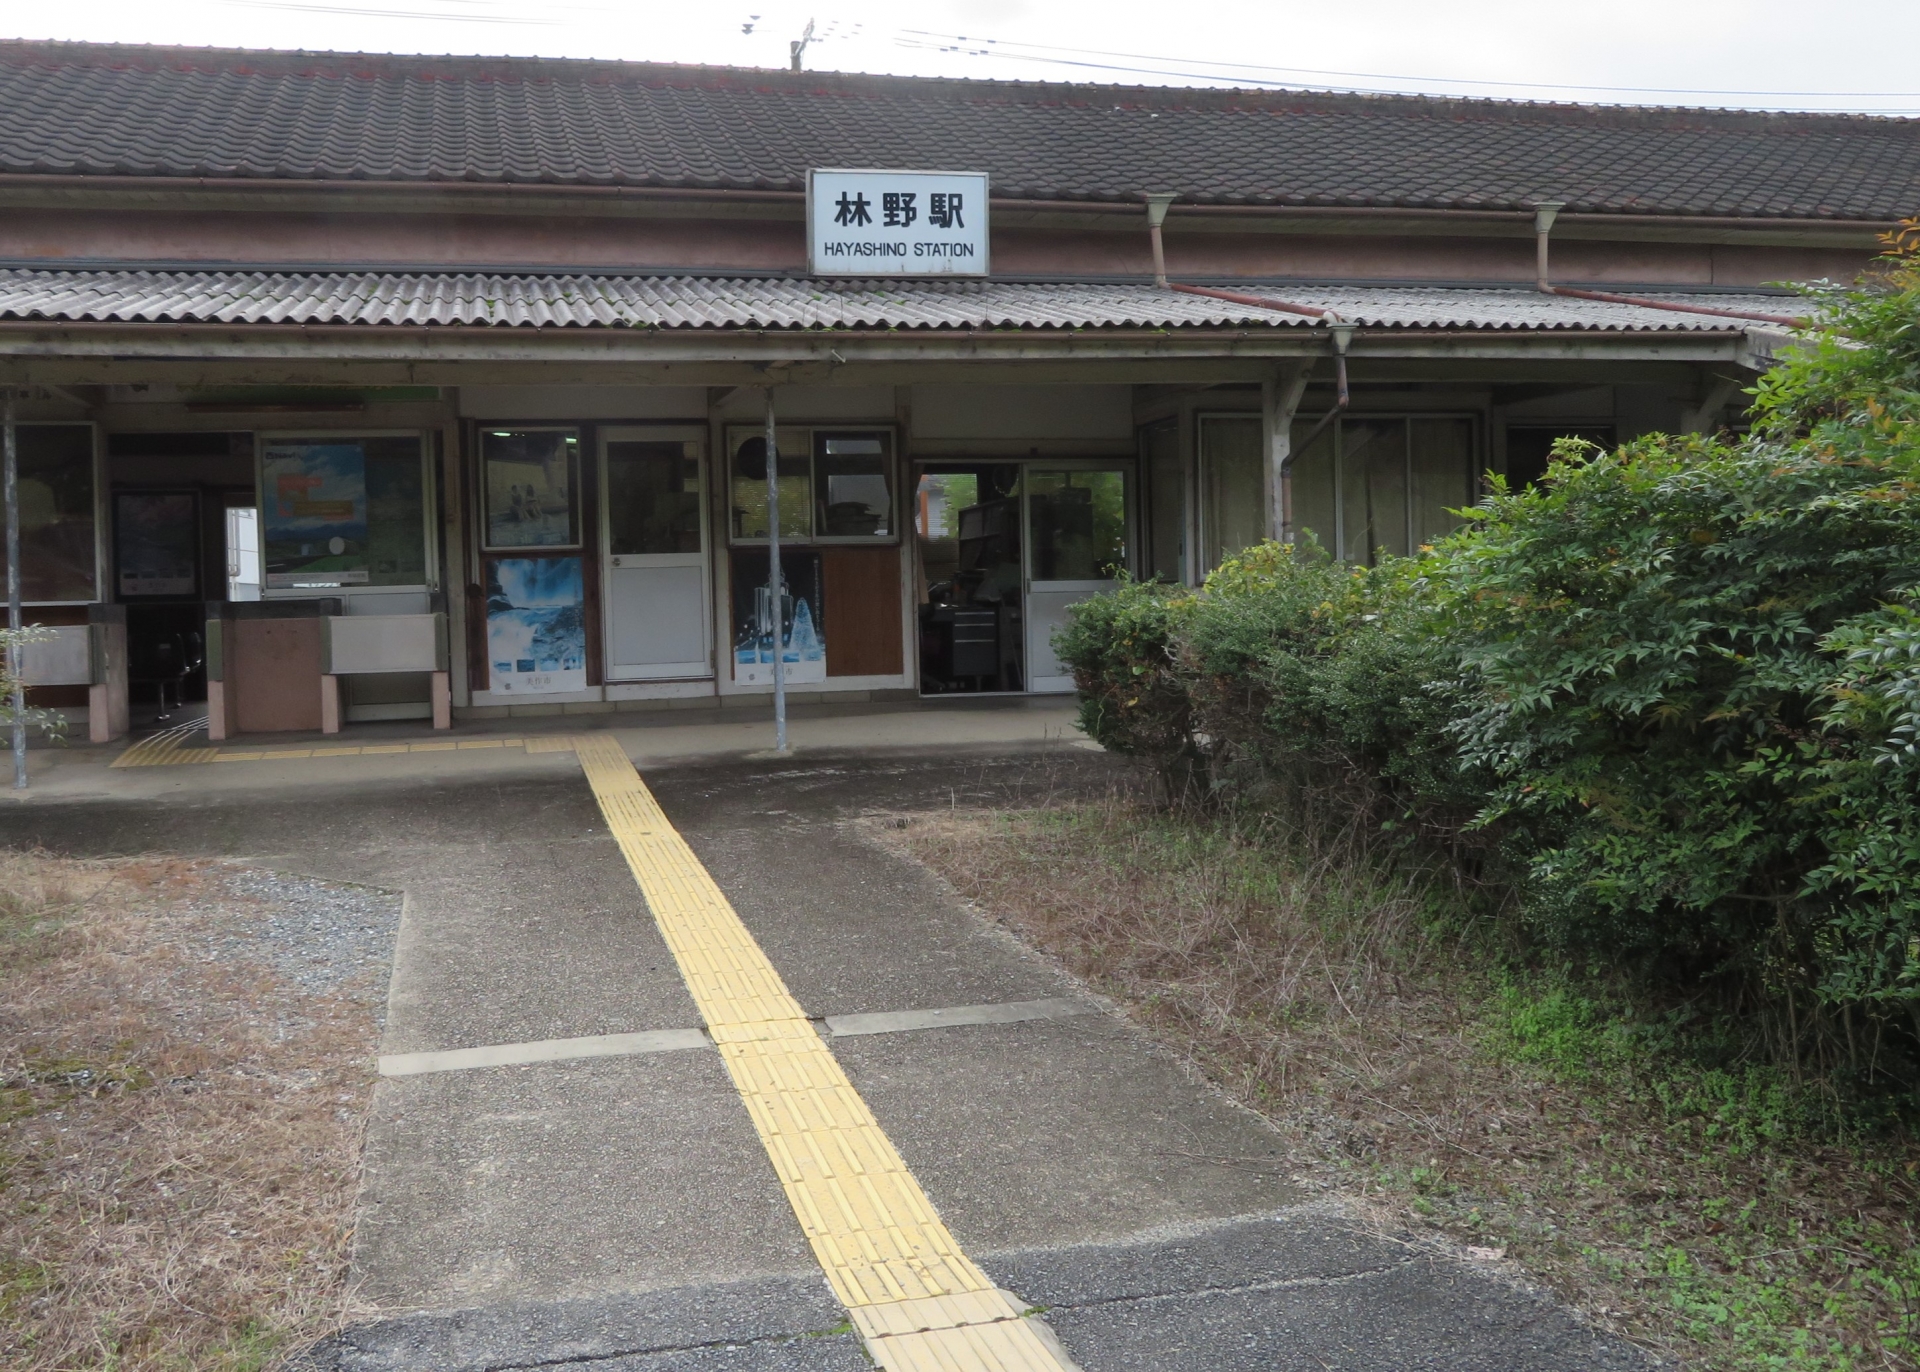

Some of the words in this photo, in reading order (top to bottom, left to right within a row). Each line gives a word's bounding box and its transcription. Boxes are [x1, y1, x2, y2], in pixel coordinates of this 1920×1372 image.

[834, 191, 965, 229] 林野駅
[824, 242, 907, 257] HAYASHINO
[914, 242, 974, 257] STATION
